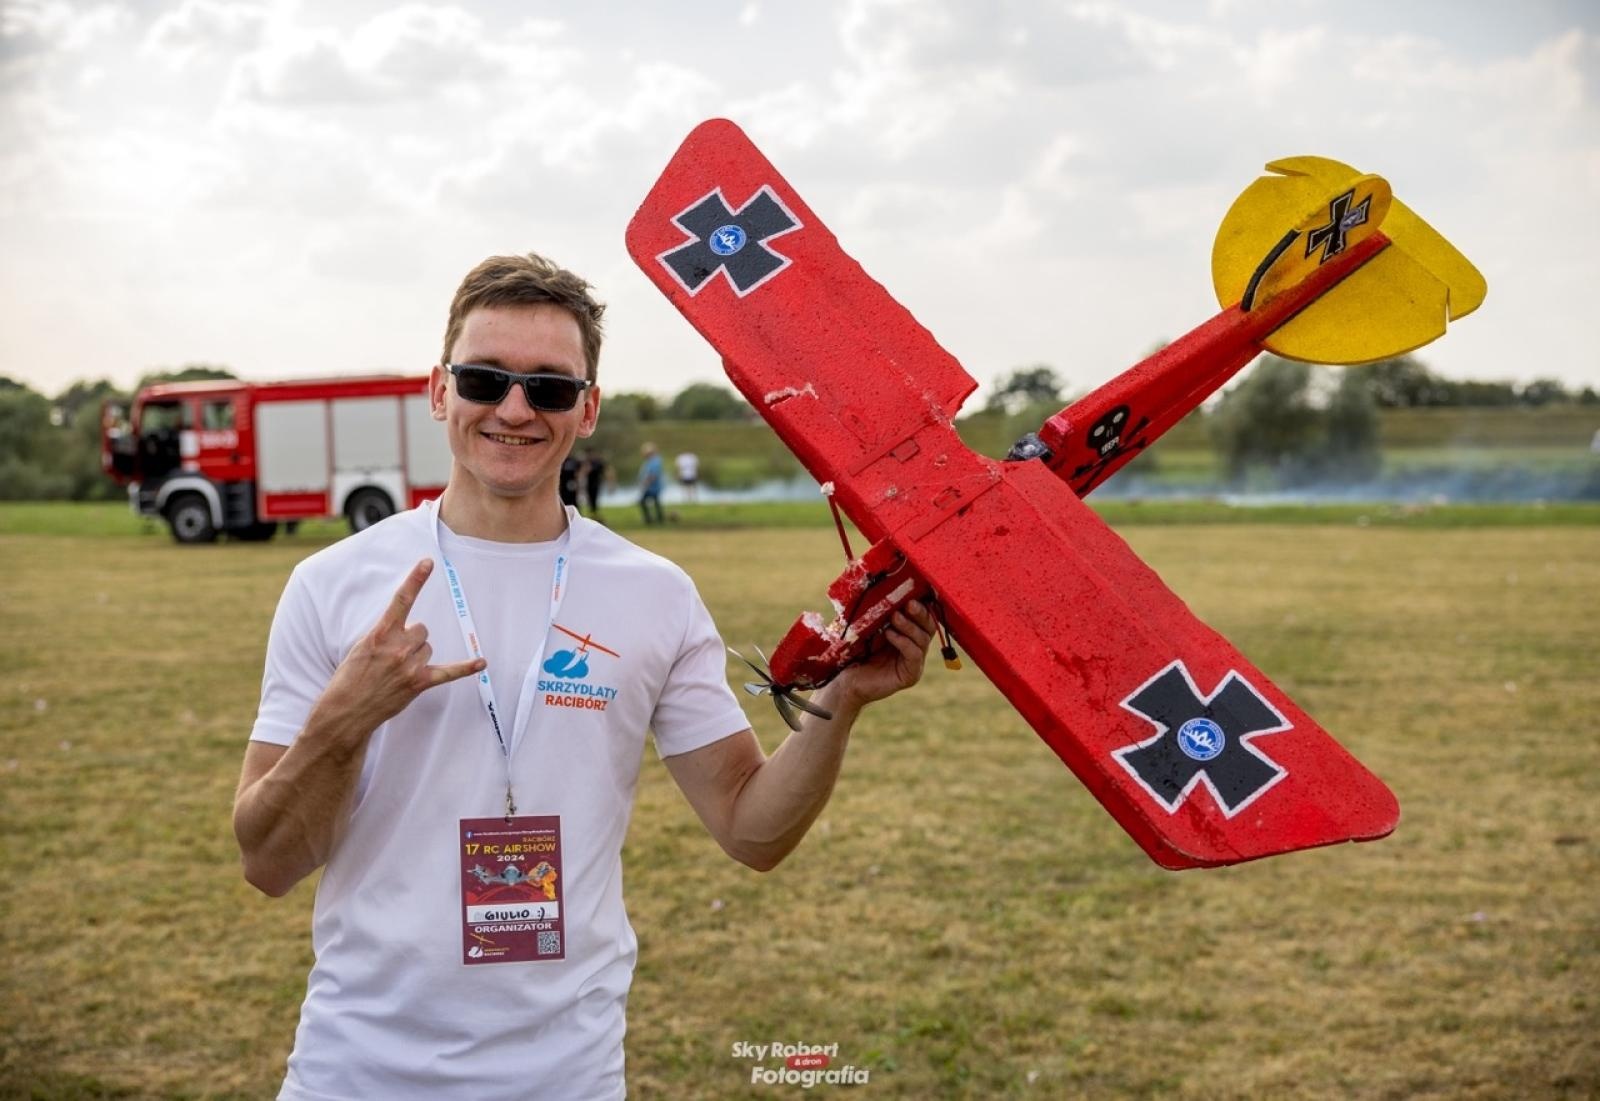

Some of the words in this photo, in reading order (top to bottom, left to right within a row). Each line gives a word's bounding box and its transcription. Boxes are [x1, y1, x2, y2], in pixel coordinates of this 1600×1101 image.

[537, 680, 618, 700] SKRZYDLATY
[545, 694, 609, 711] RACIBÓRZ
[465, 844, 480, 855] 17
[483, 845, 499, 854] RC
[496, 854, 525, 862] 2024
[484, 909, 530, 921] GIULIO
[474, 922, 552, 933] ORGANIZATOR
